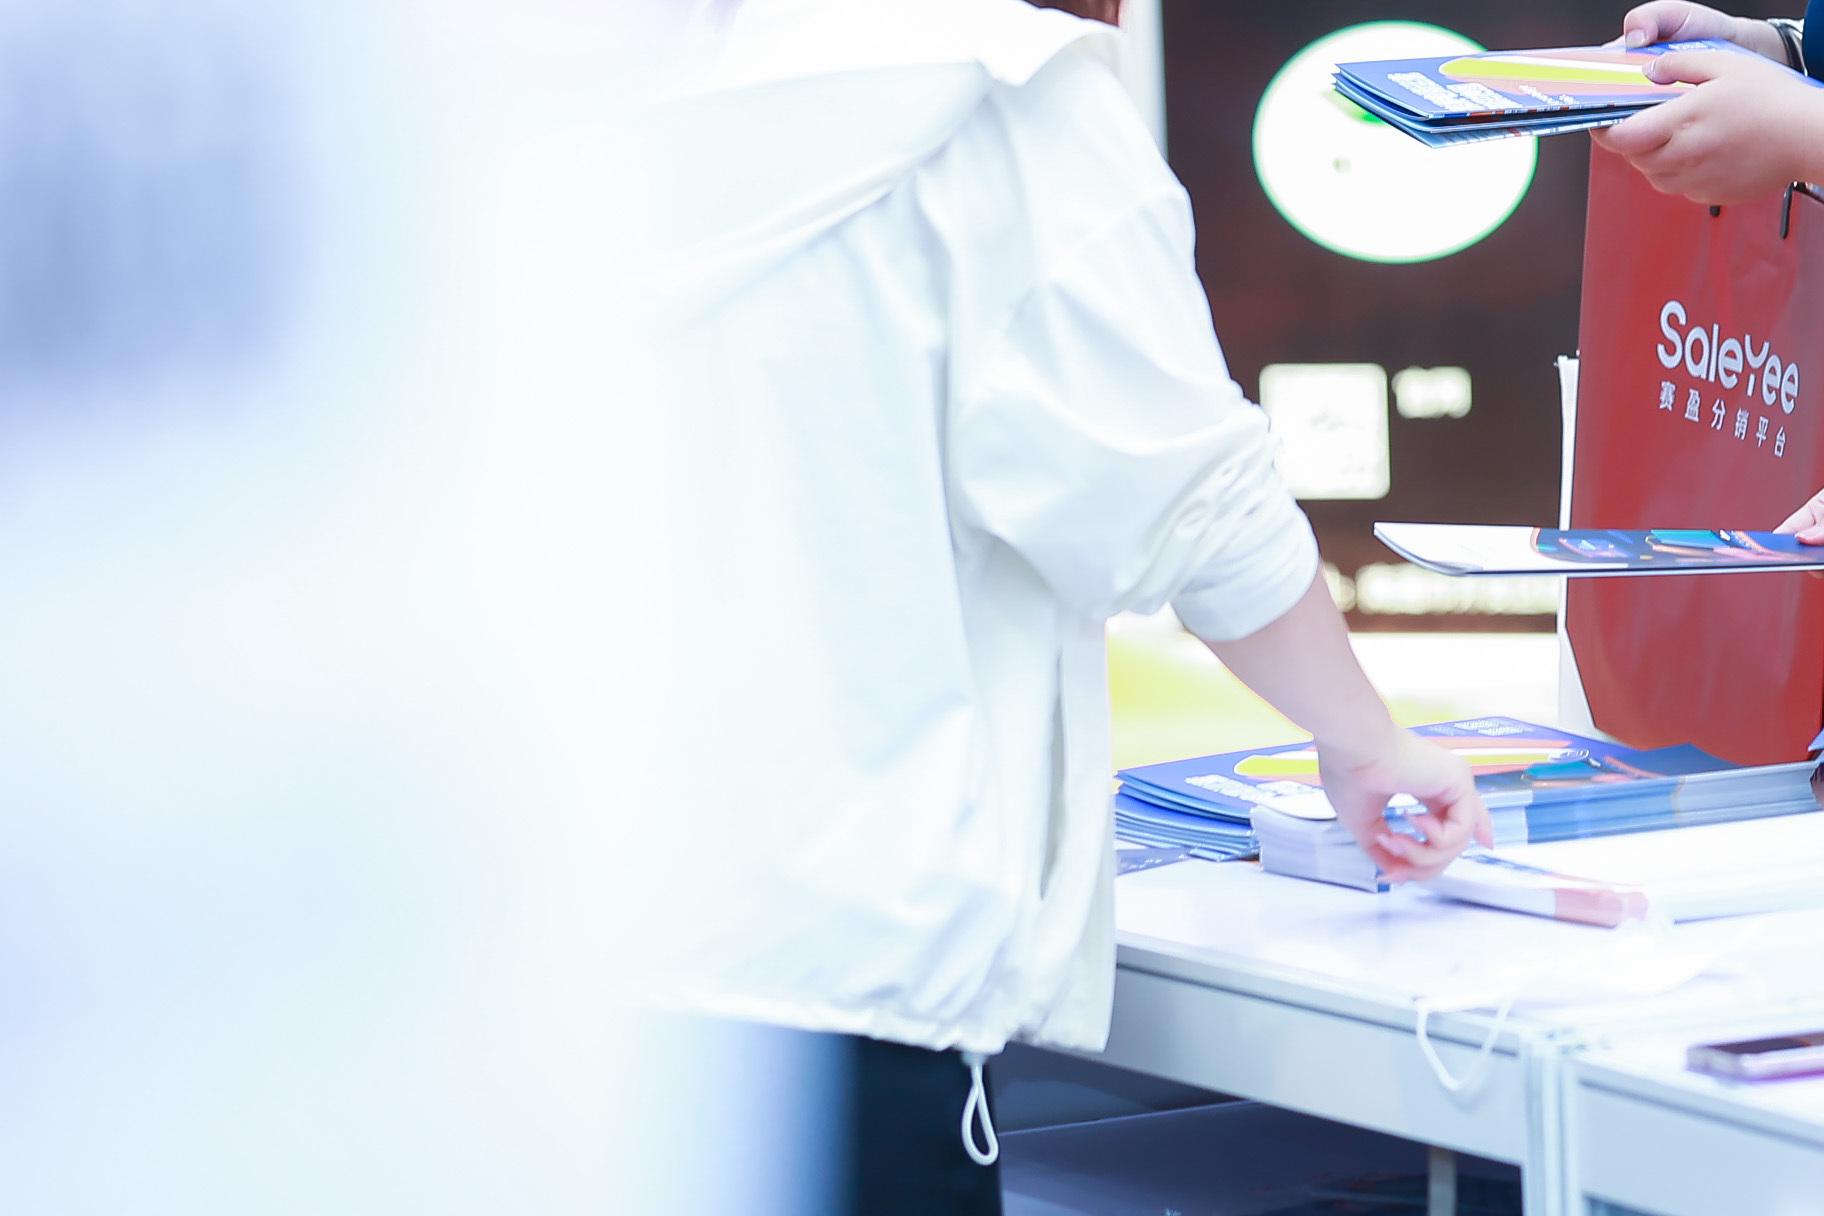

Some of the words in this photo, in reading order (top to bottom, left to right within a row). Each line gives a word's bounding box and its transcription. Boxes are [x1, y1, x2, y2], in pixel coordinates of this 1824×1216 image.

[1659, 380, 1787, 458] 赛盈分销平台
